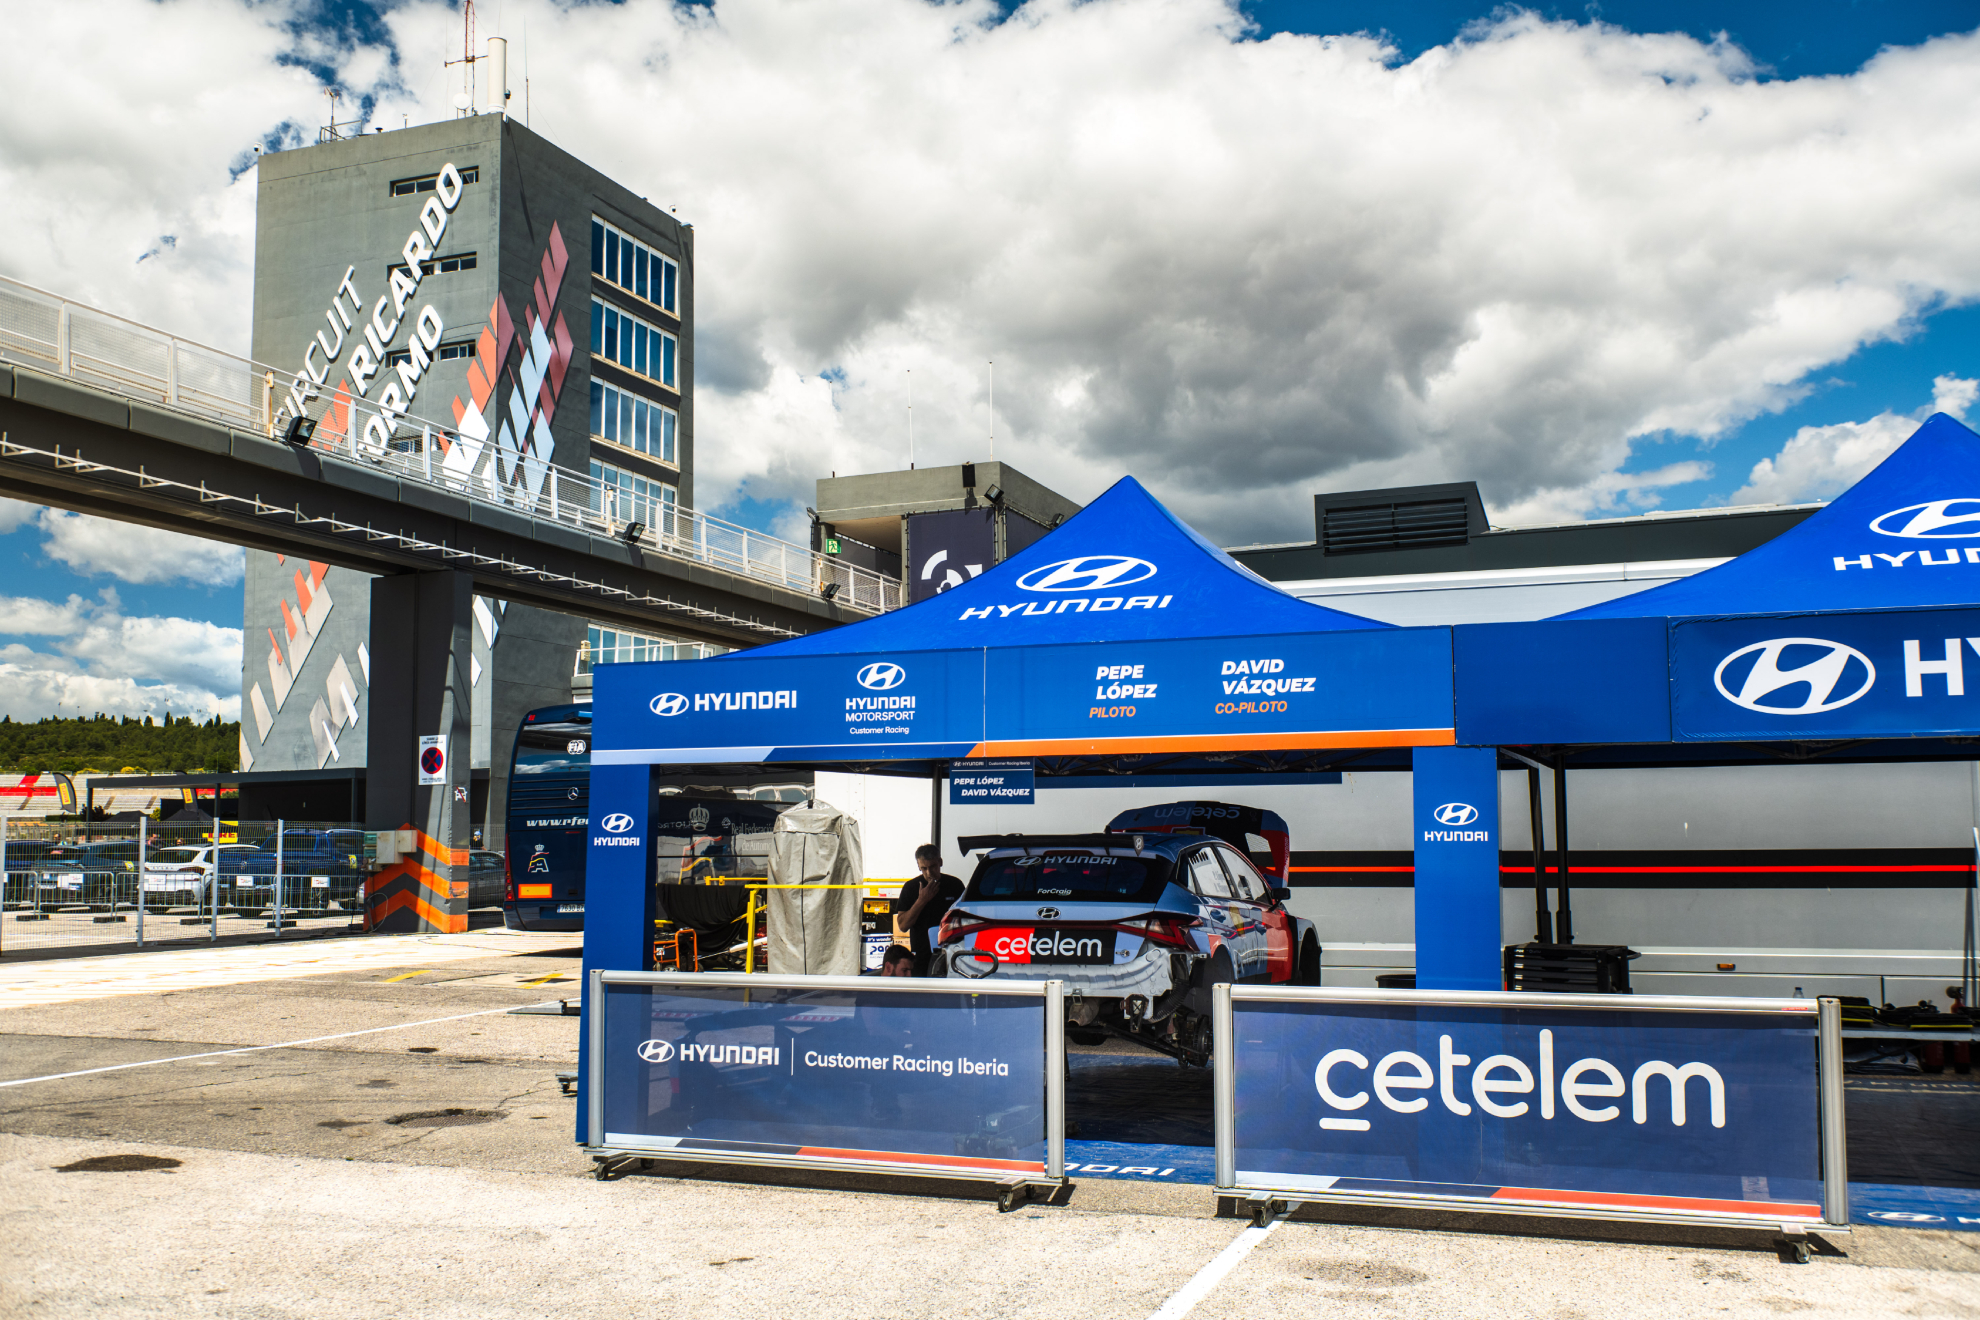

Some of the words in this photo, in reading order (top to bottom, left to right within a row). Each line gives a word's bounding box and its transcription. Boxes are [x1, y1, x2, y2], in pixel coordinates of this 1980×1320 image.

[347, 162, 463, 398] RICARDO
[959, 594, 1174, 621] HYUNDAI
[1096, 664, 1145, 681] PEPE
[1221, 658, 1285, 676] DAVID
[1096, 682, 1158, 700] LÓPEZ
[1222, 673, 1317, 697] VÁZQUEZ
[694, 690, 797, 712] HYUNDAI
[845, 695, 916, 710] HYUNDAI
[1214, 700, 1288, 715] CO-PILOTO
[845, 710, 916, 722] MOTORSPORT
[1089, 705, 1137, 719] PILOTO
[849, 726, 882, 735] Customer
[884, 725, 910, 735] Racing
[977, 776, 1004, 785] LÓPEZ
[990, 787, 1030, 797] VÁZQUEZ
[1154, 806, 1241, 820] cetelem
[731, 823, 744, 834] Real
[1424, 830, 1489, 842] HYUNDAI
[593, 837, 640, 847] HYUNDAI
[1043, 855, 1119, 866] HYUNDAI
[1037, 888, 1072, 896] ForCraig
[994, 930, 1103, 962] cetelem
[680, 1042, 780, 1066] HYUNDAI
[804, 1050, 889, 1071] Customer
[892, 1054, 954, 1077] Racing
[958, 1057, 1009, 1077] Iberia
[1314, 1028, 1726, 1132] cetelem
